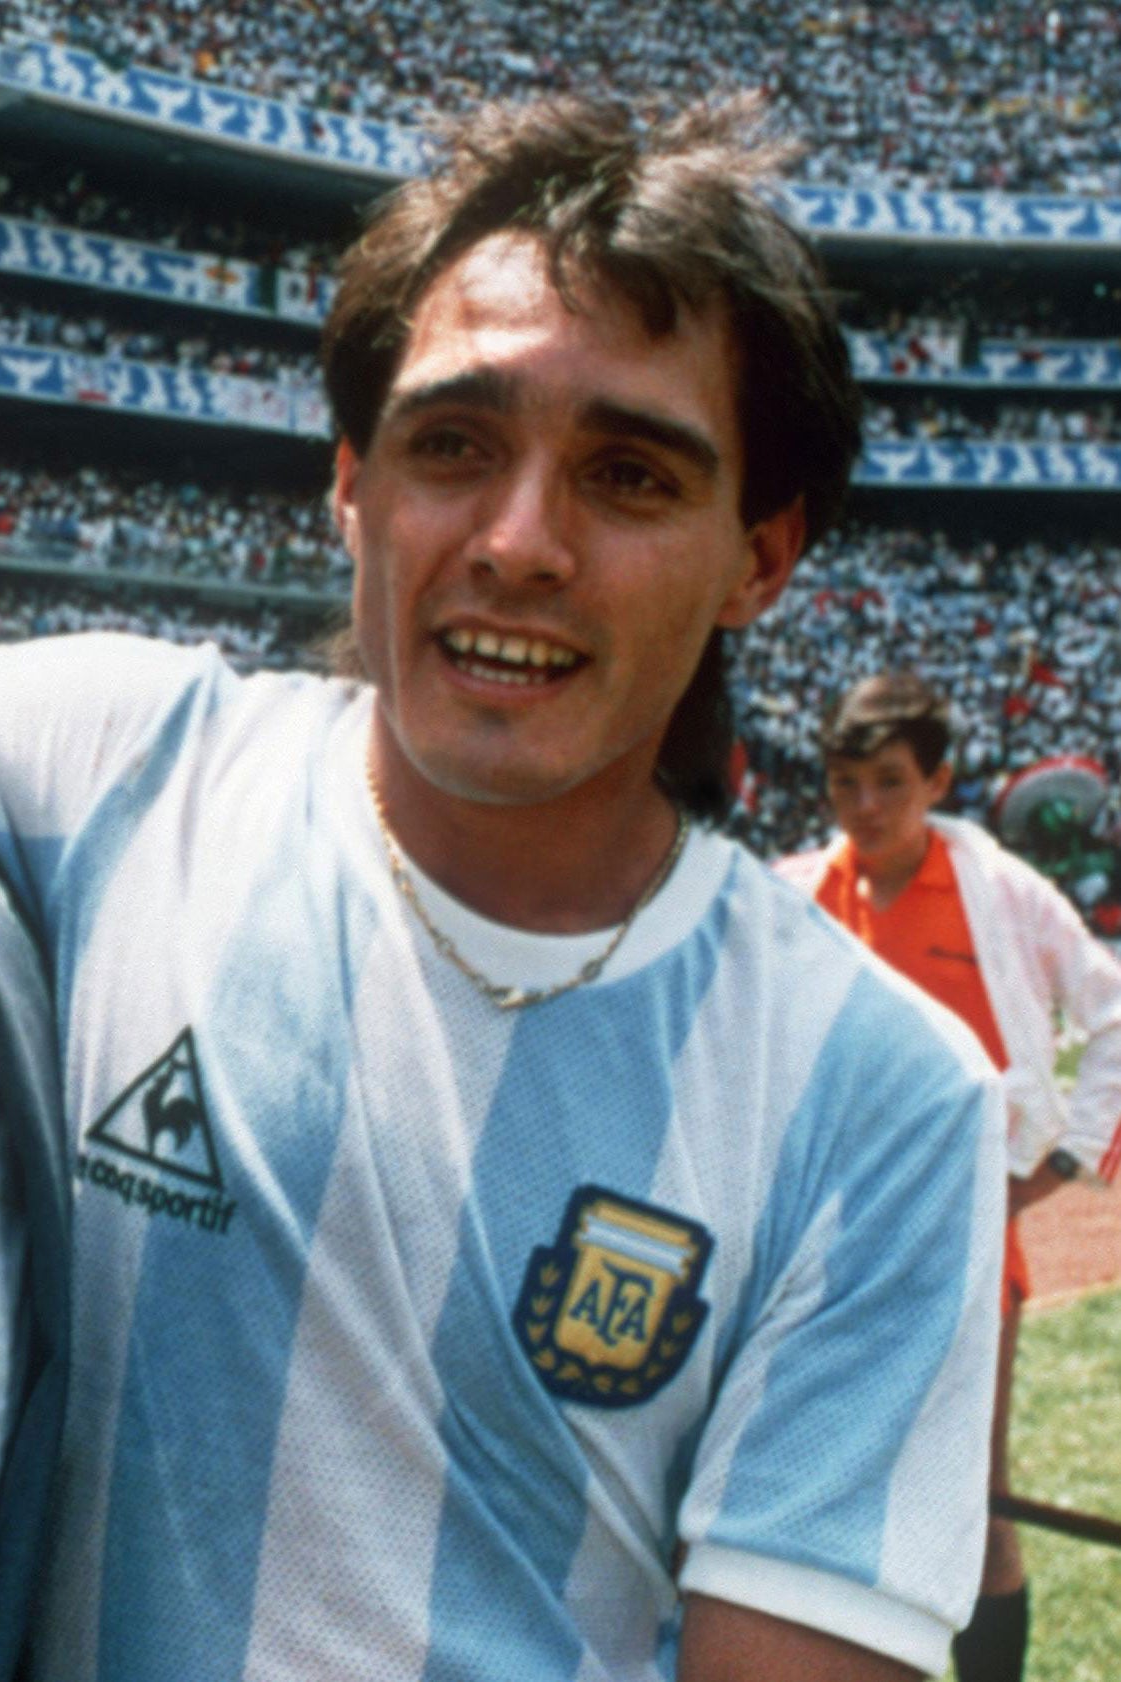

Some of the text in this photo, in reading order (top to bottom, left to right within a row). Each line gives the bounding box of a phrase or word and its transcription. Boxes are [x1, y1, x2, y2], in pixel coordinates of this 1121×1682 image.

[89, 1158, 136, 1204] coq
[137, 1179, 238, 1234] sportif
[570, 1259, 655, 1346] AFA
